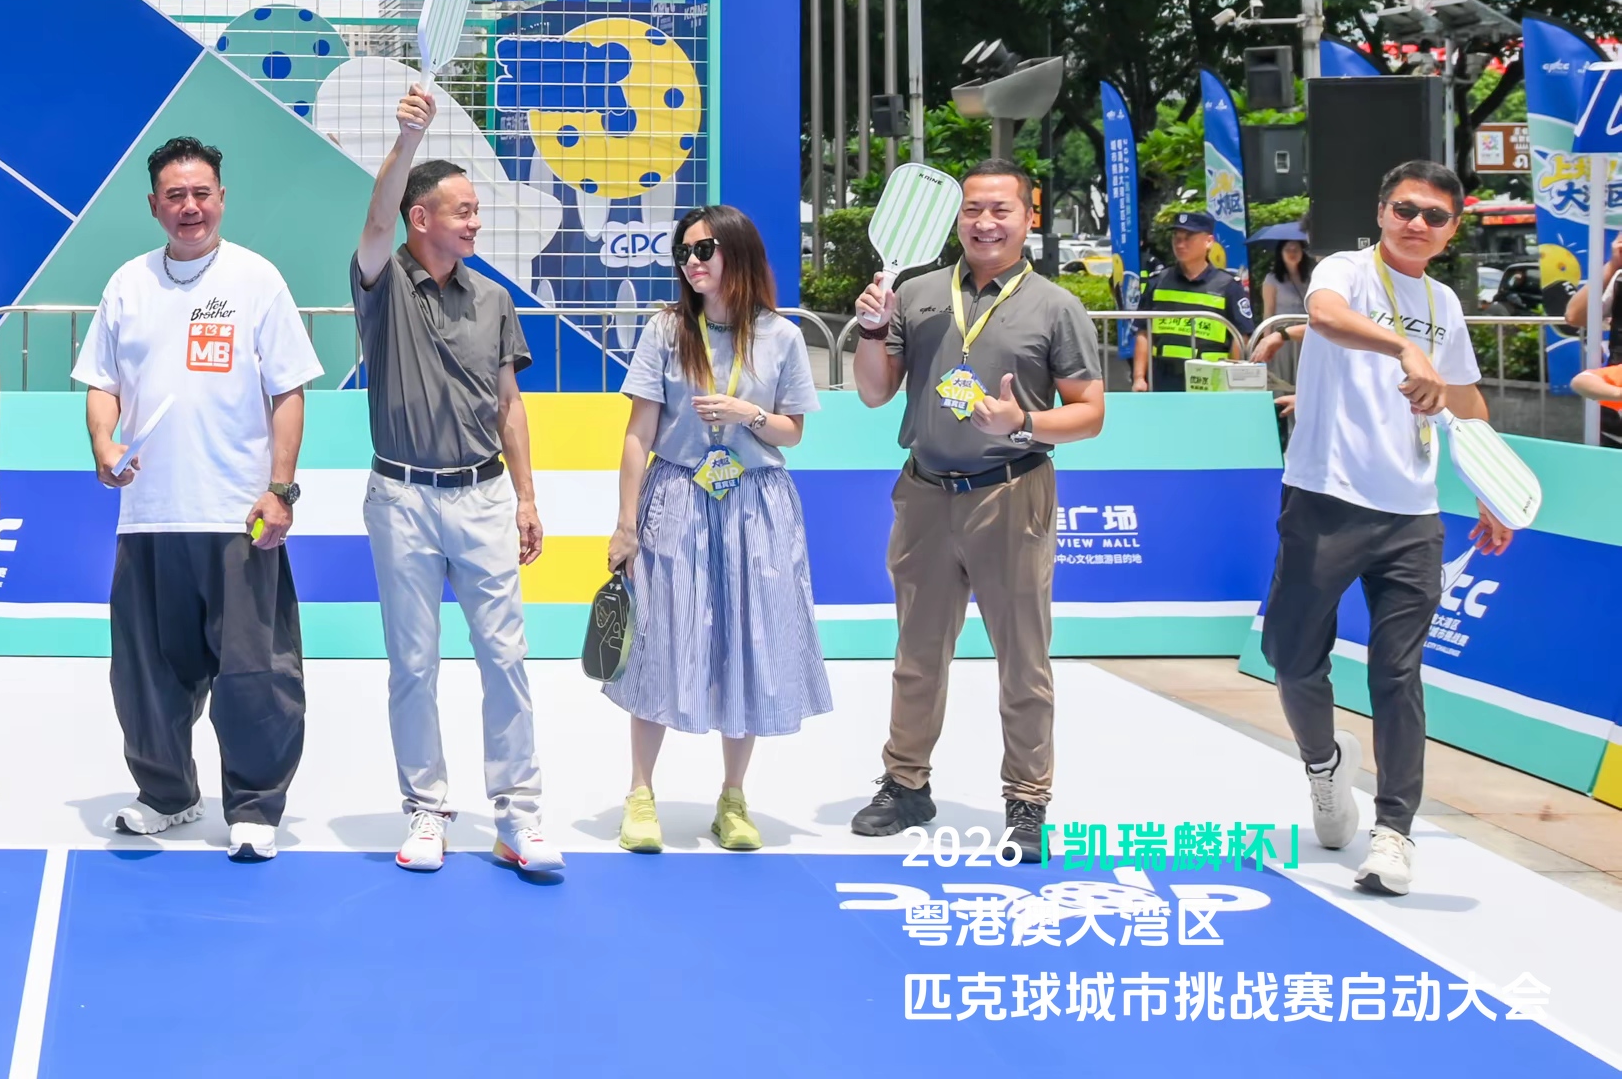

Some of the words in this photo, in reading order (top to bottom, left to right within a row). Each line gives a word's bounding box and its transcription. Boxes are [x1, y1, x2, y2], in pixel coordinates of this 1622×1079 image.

[919, 173, 943, 185] KRINE
[205, 296, 228, 311] Hey
[190, 307, 236, 322] Brother
[190, 340, 231, 363] MB
[942, 385, 975, 401] SVIP
[705, 467, 739, 484] SVIP
[1057, 538, 1094, 548] VIEW
[1102, 538, 1141, 548] MALL
[1054, 553, 1143, 564] 中心文化旅游目的地
